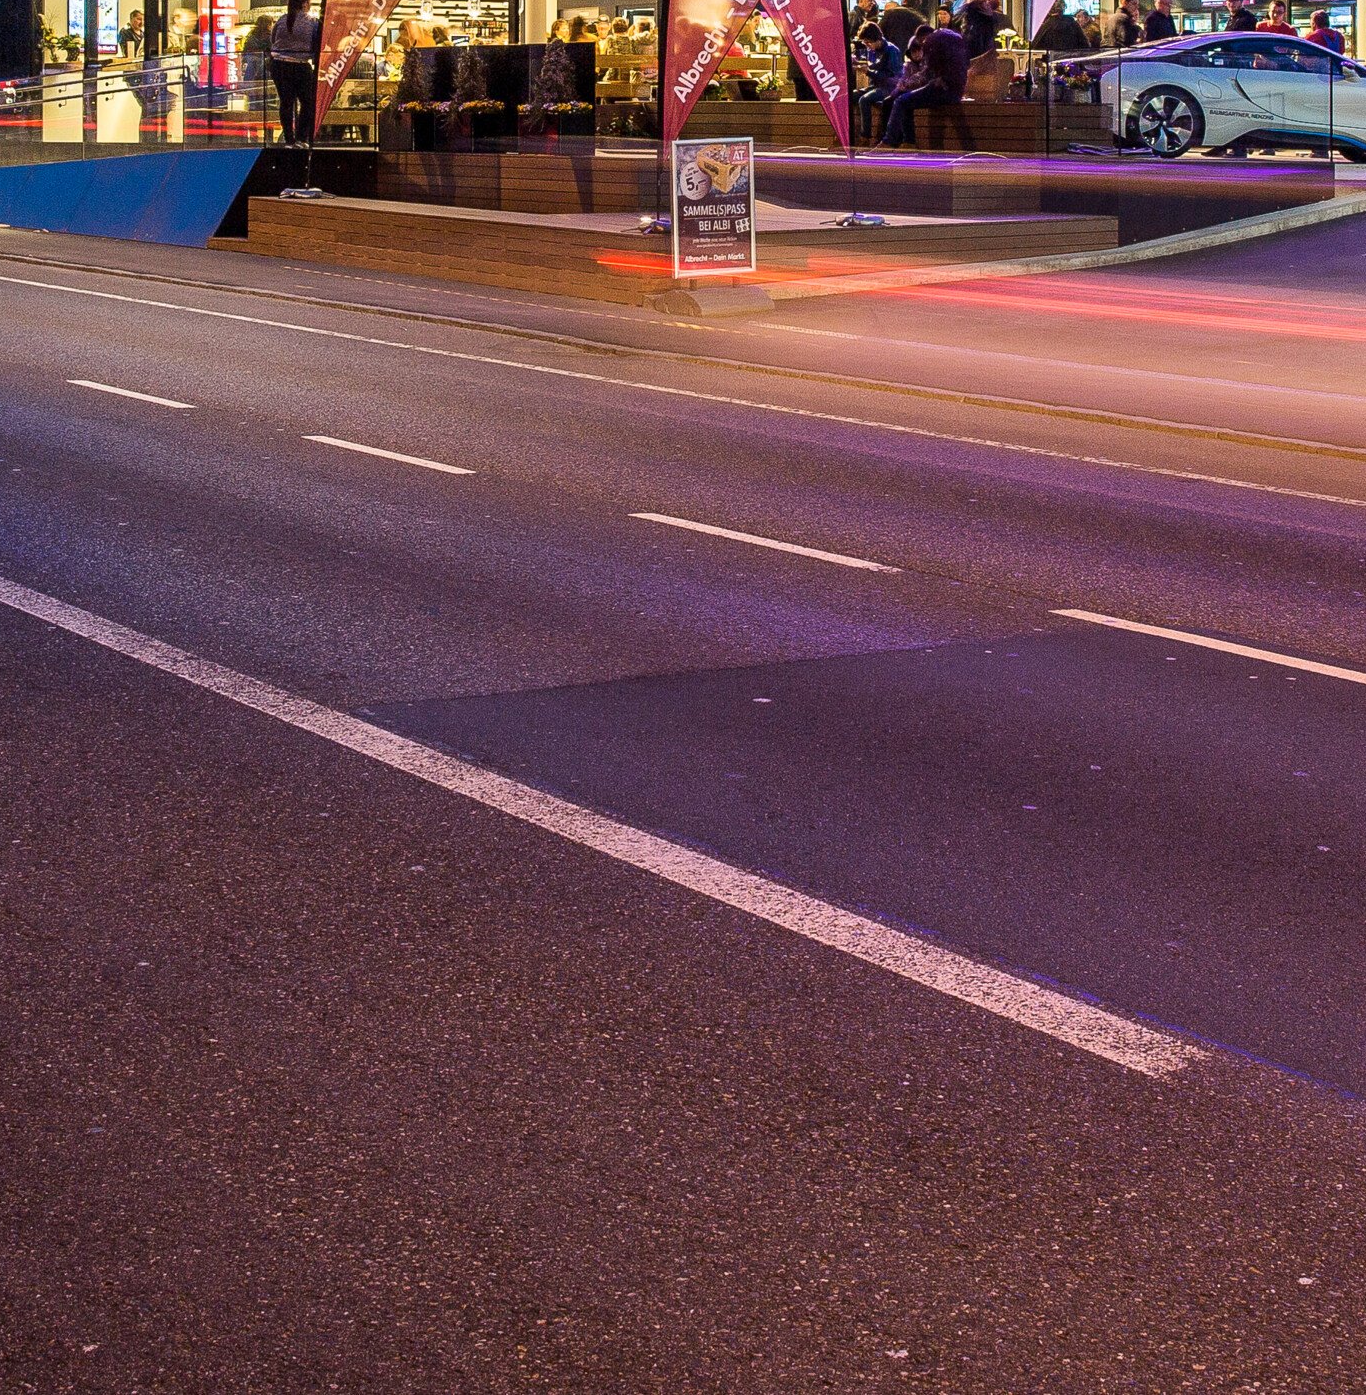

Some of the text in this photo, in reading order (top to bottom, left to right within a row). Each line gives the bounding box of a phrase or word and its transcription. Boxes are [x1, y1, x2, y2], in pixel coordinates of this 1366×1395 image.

[324, 20, 369, 88] Albrecht
[673, 25, 729, 104] Albrecht
[732, 150, 745, 160] AT
[683, 204, 746, 217] SAMMEL(S)PASS
[699, 219, 730, 231] BEI ALBI
